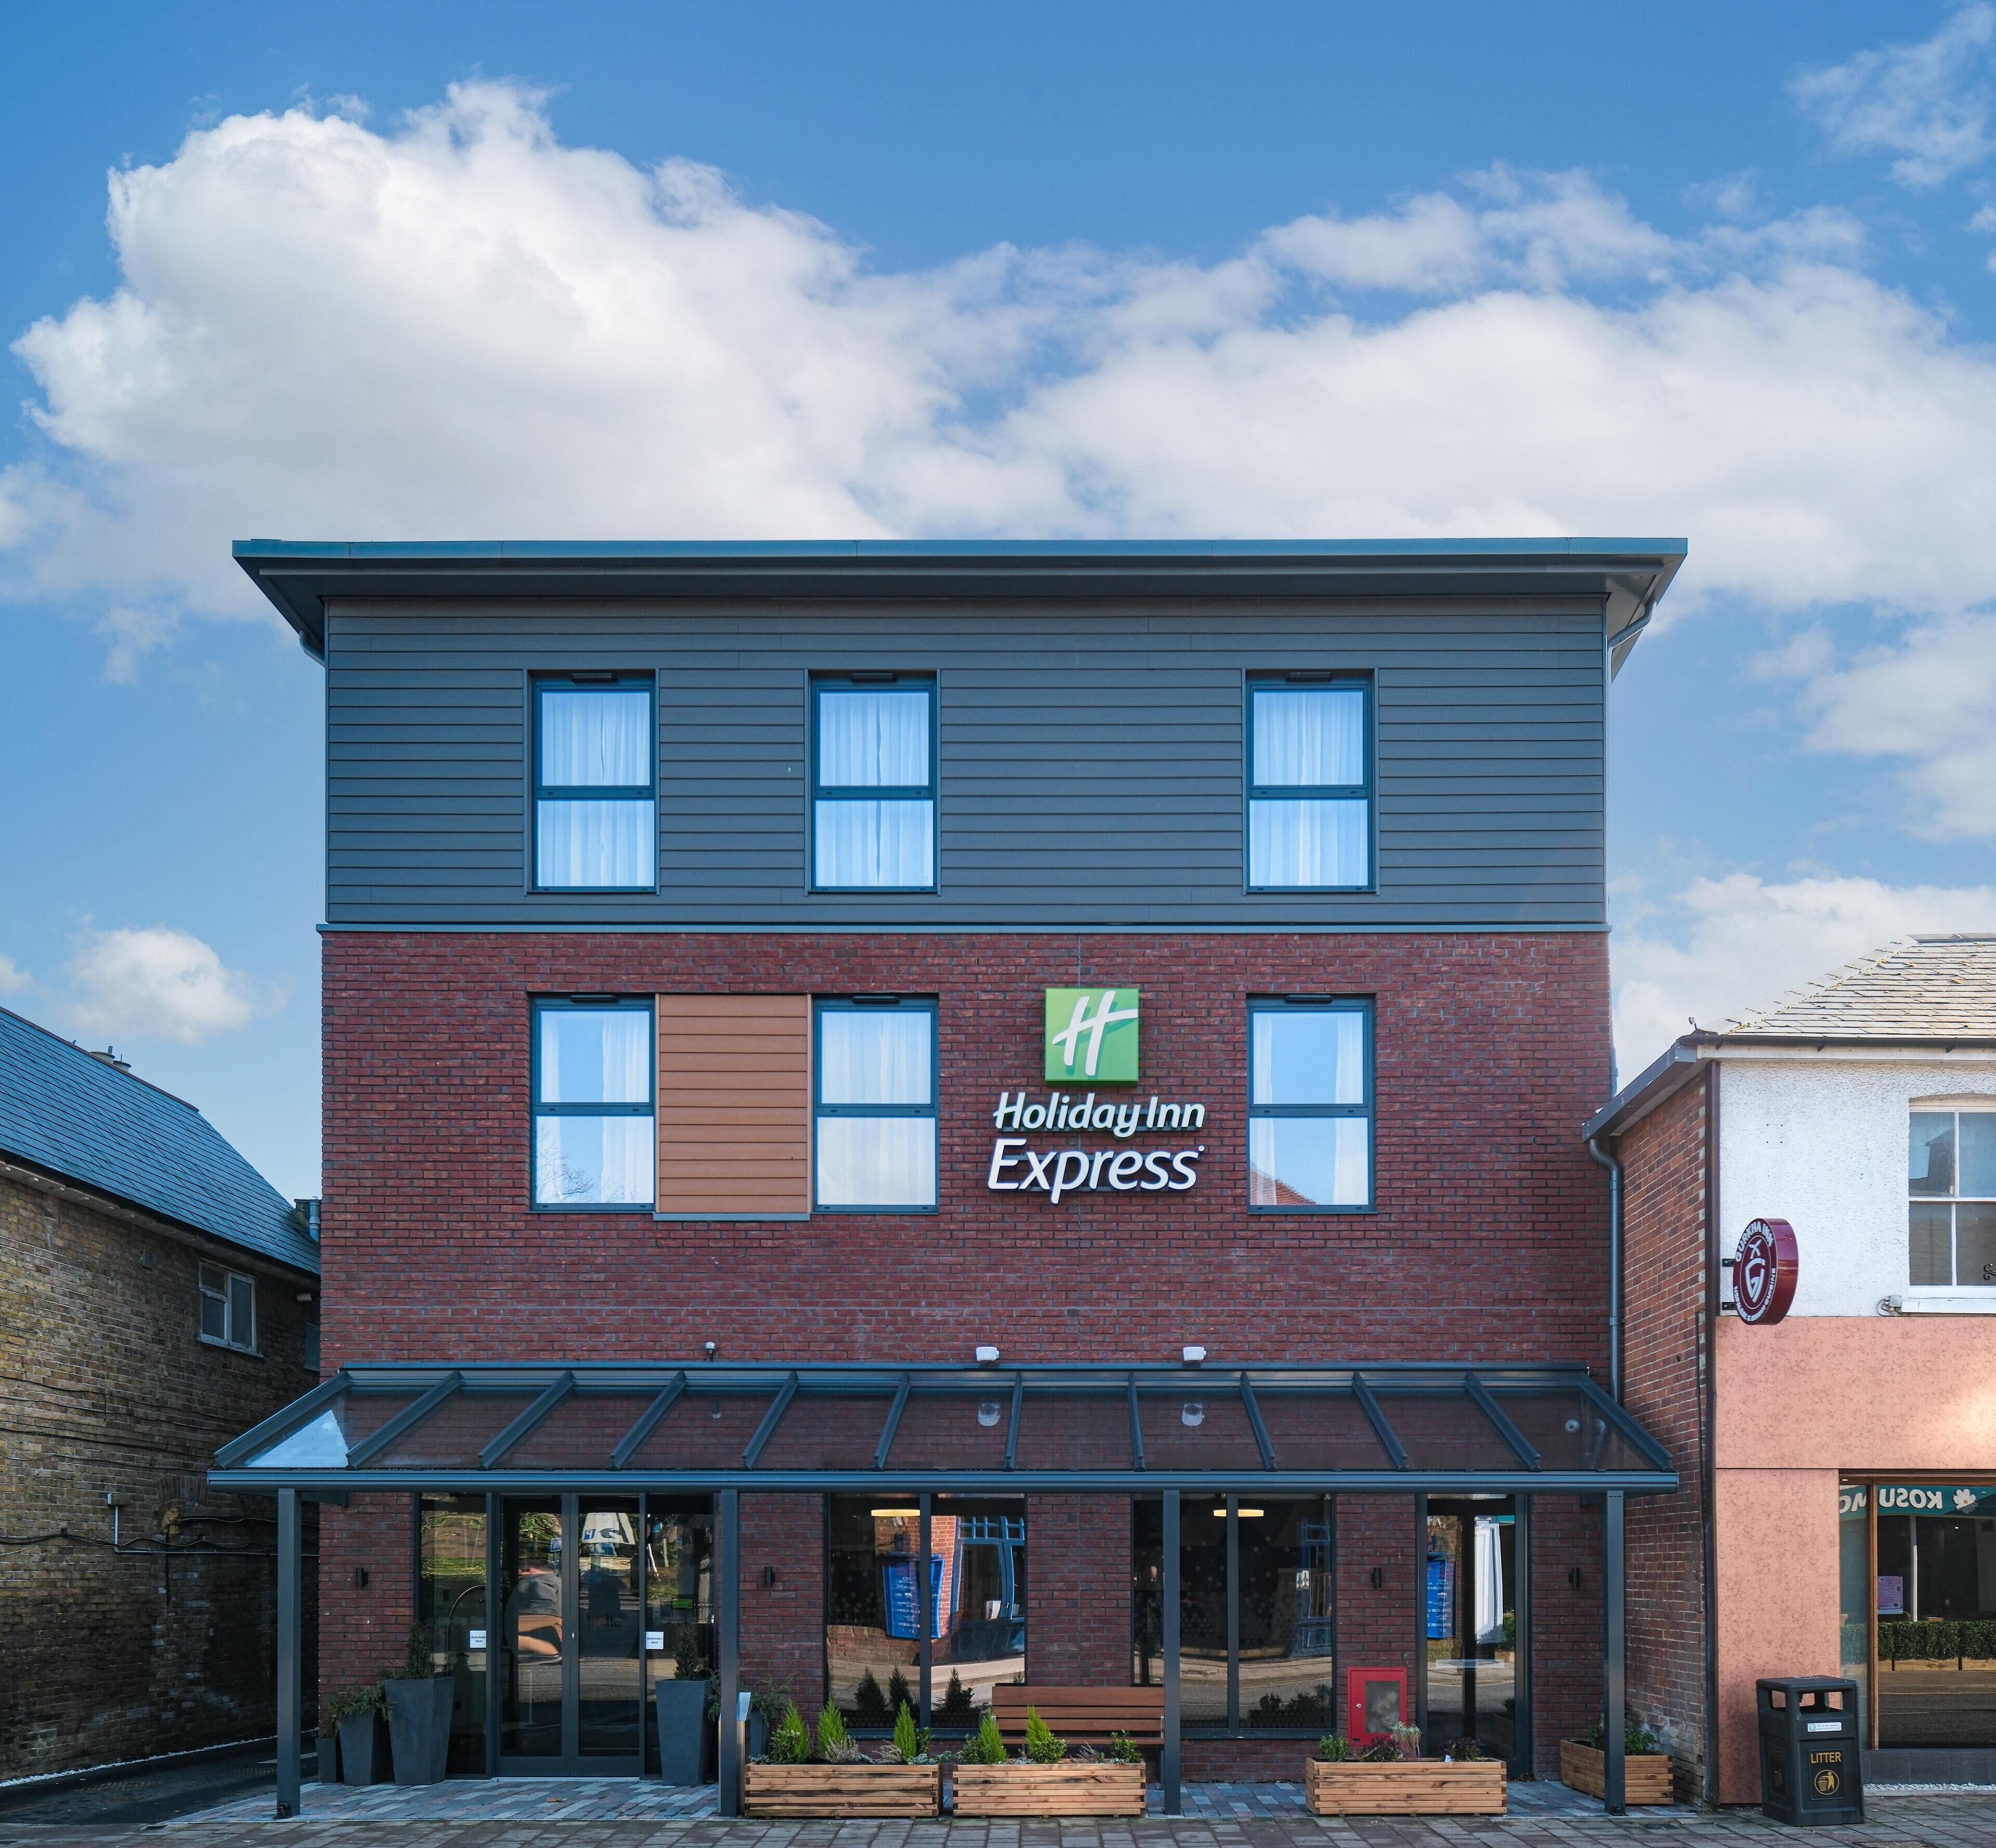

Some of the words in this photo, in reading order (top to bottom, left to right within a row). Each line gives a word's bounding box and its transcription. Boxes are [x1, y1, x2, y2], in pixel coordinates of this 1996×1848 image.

[993, 1092, 1141, 1138] Holiday
[1146, 1096, 1205, 1128] Inn
[987, 1138, 1199, 1204] Express
[1735, 1221, 1762, 1262] GURKHA
[1762, 1224, 1774, 1247] INN
[1810, 1752, 1842, 1764] LITTER
